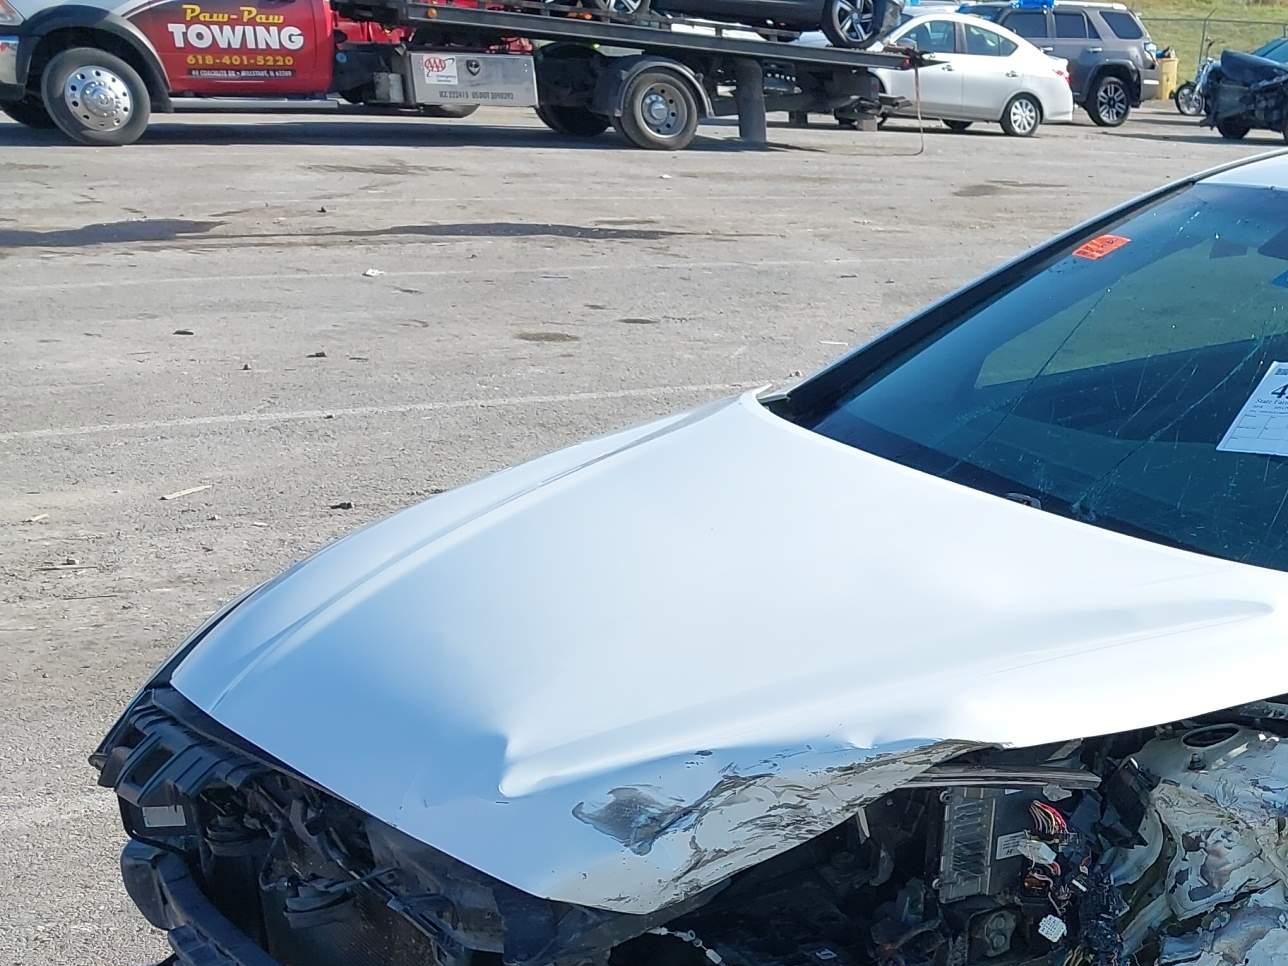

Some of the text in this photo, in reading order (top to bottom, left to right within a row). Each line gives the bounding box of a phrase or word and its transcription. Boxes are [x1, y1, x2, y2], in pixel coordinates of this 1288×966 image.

[182, 5, 284, 24] Paw-Paw
[168, 23, 305, 50] TOWING
[186, 55, 294, 66] 618-401-5220
